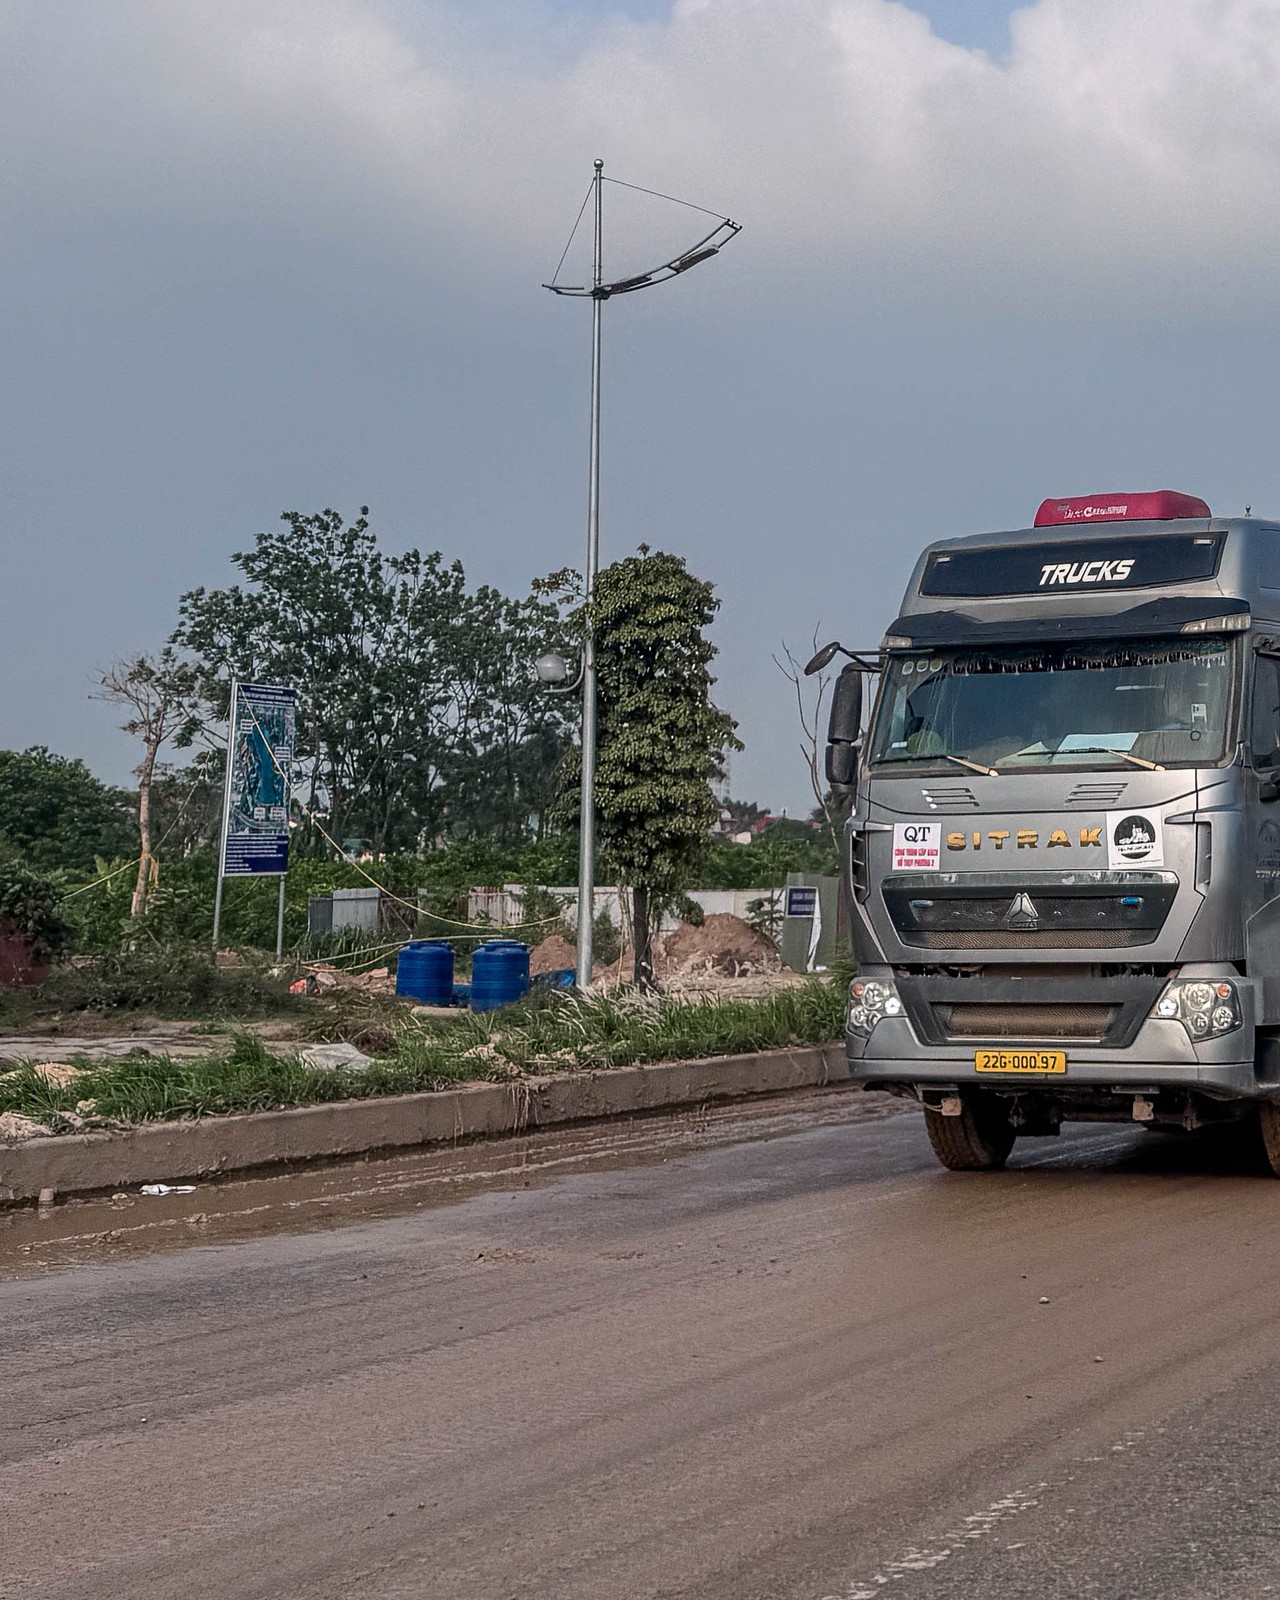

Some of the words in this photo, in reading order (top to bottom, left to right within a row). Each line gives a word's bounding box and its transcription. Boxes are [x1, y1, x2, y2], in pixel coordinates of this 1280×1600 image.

[1039, 559, 1135, 586] TRUCKS
[904, 826, 931, 843] QT
[946, 826, 1103, 851] SITRAK
